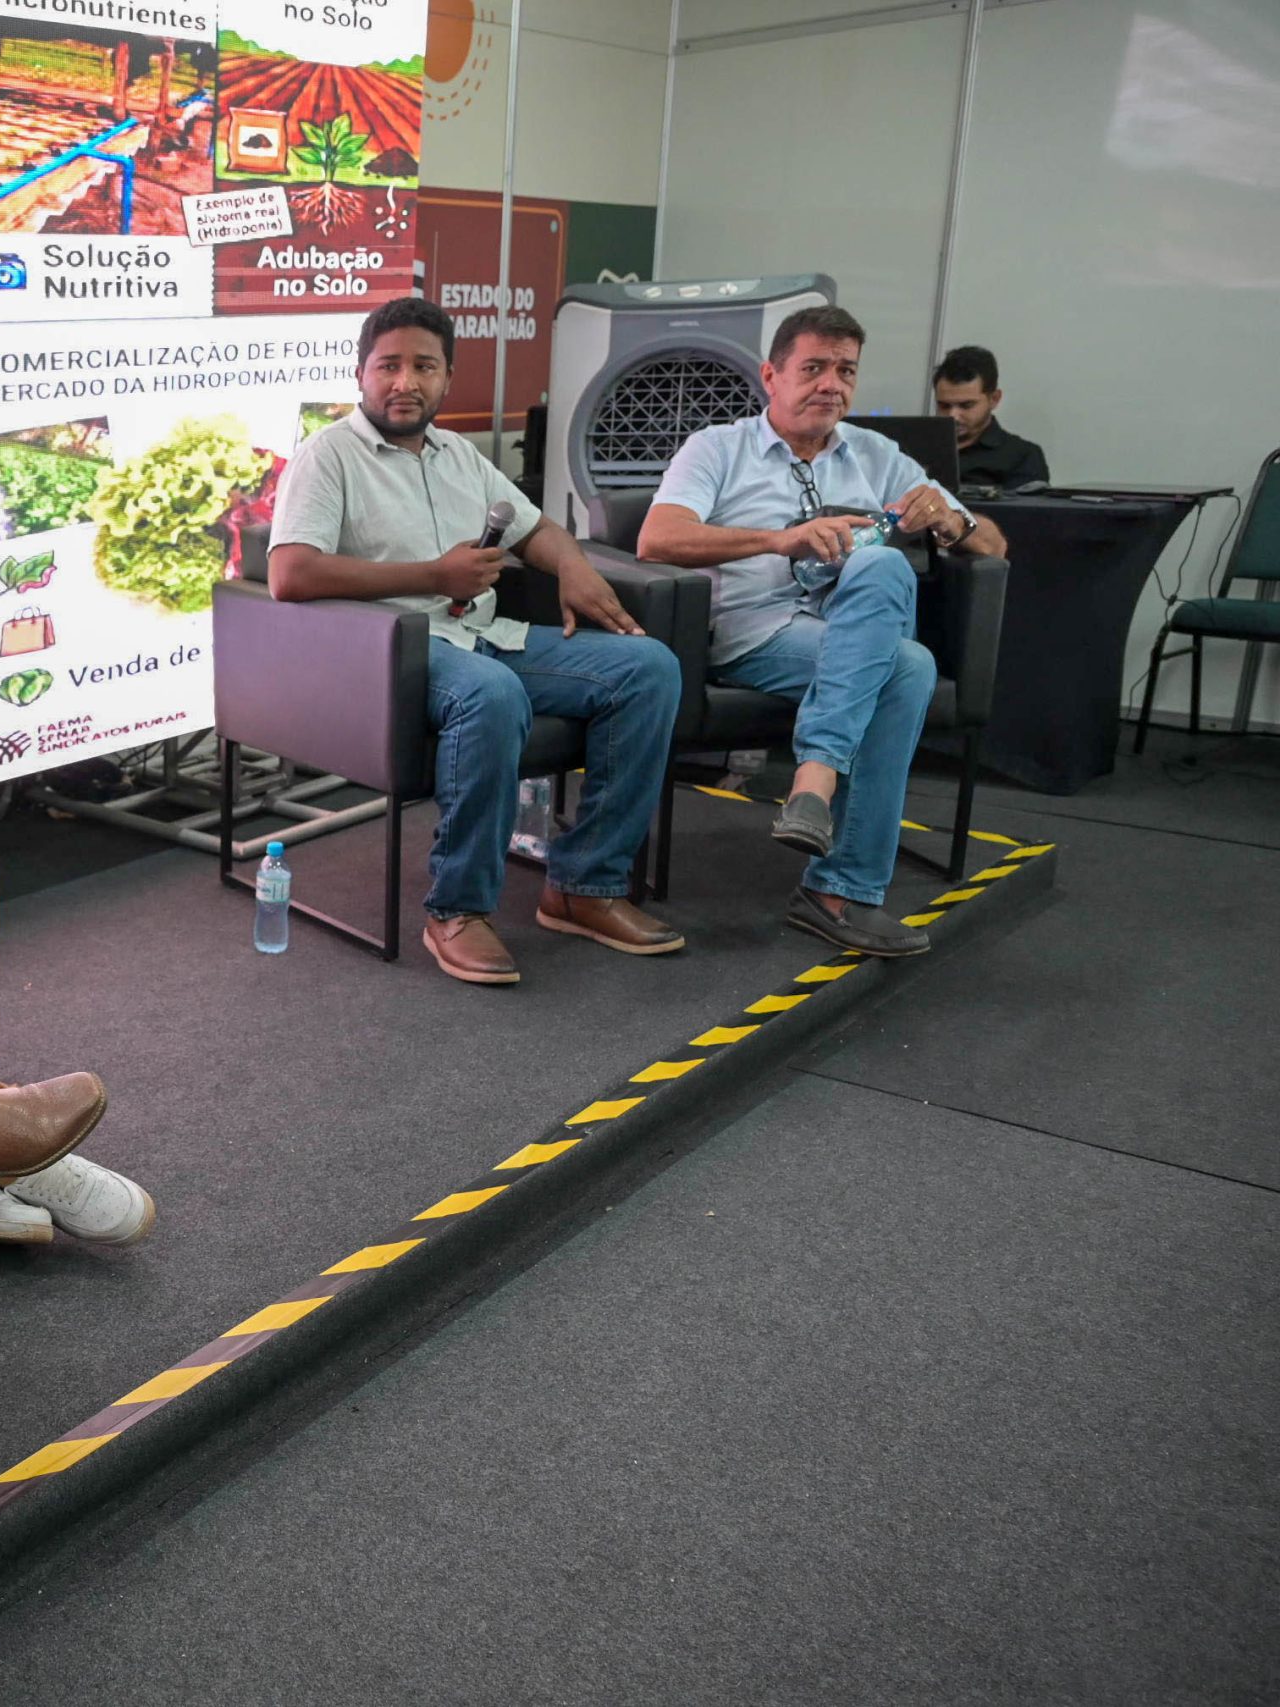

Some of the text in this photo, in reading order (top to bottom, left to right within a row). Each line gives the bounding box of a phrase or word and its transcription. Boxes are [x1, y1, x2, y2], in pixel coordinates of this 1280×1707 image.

[285, 3, 372, 30] no Solo
[44, 244, 171, 273] Solução
[257, 245, 384, 273] Adubação
[44, 275, 179, 300] Nutritiva
[274, 274, 368, 297] no Solo
[514, 287, 535, 310] DO
[248, 342, 275, 360] DE
[114, 377, 145, 395] DA
[68, 645, 200, 687] Venda de
